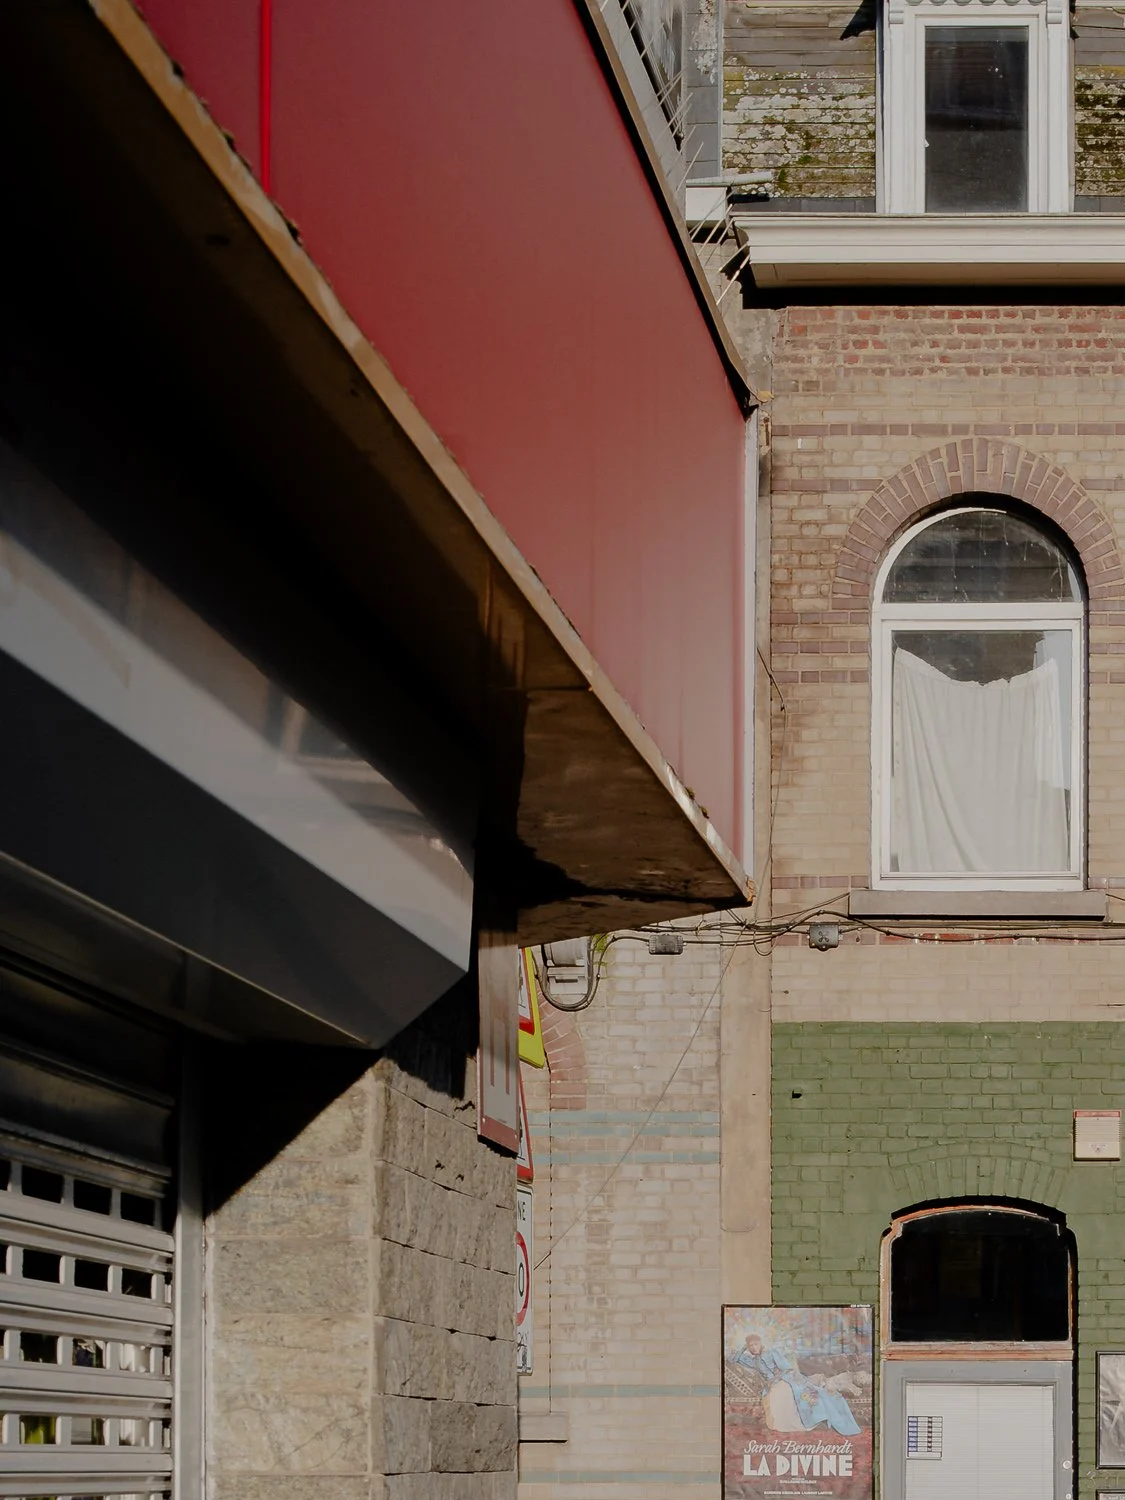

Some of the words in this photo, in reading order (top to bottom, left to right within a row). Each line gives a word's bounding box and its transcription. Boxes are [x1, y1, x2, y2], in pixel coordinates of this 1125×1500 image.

[743, 1439, 781, 1454] Sarah
[743, 1454, 771, 1476] LA
[776, 1454, 853, 1476] DIVINE
